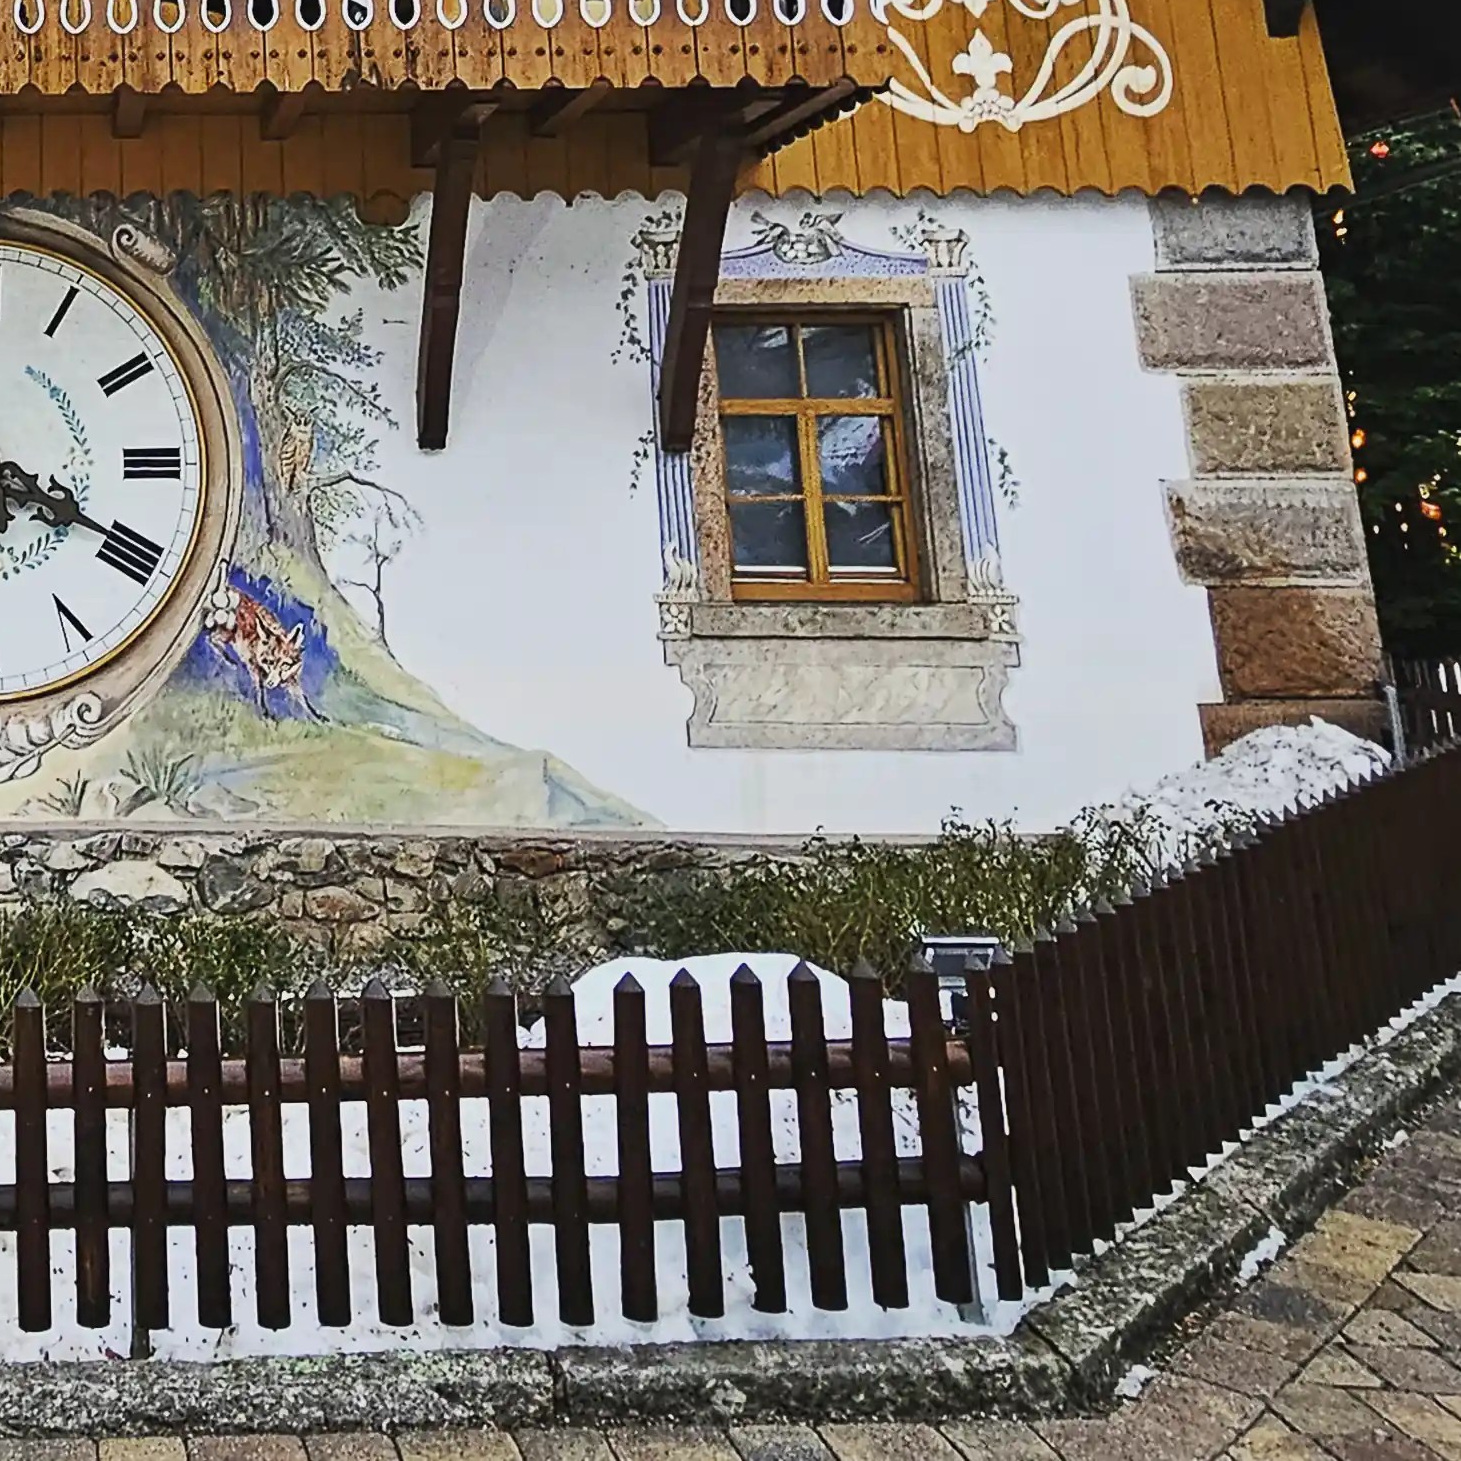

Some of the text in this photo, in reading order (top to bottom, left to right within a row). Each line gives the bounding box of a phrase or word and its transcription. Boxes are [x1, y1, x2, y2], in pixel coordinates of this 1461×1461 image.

[97, 351, 155, 398] II
[122, 447, 181, 480] III
[95, 519, 165, 587] IIII
[52, 592, 94, 654] V
